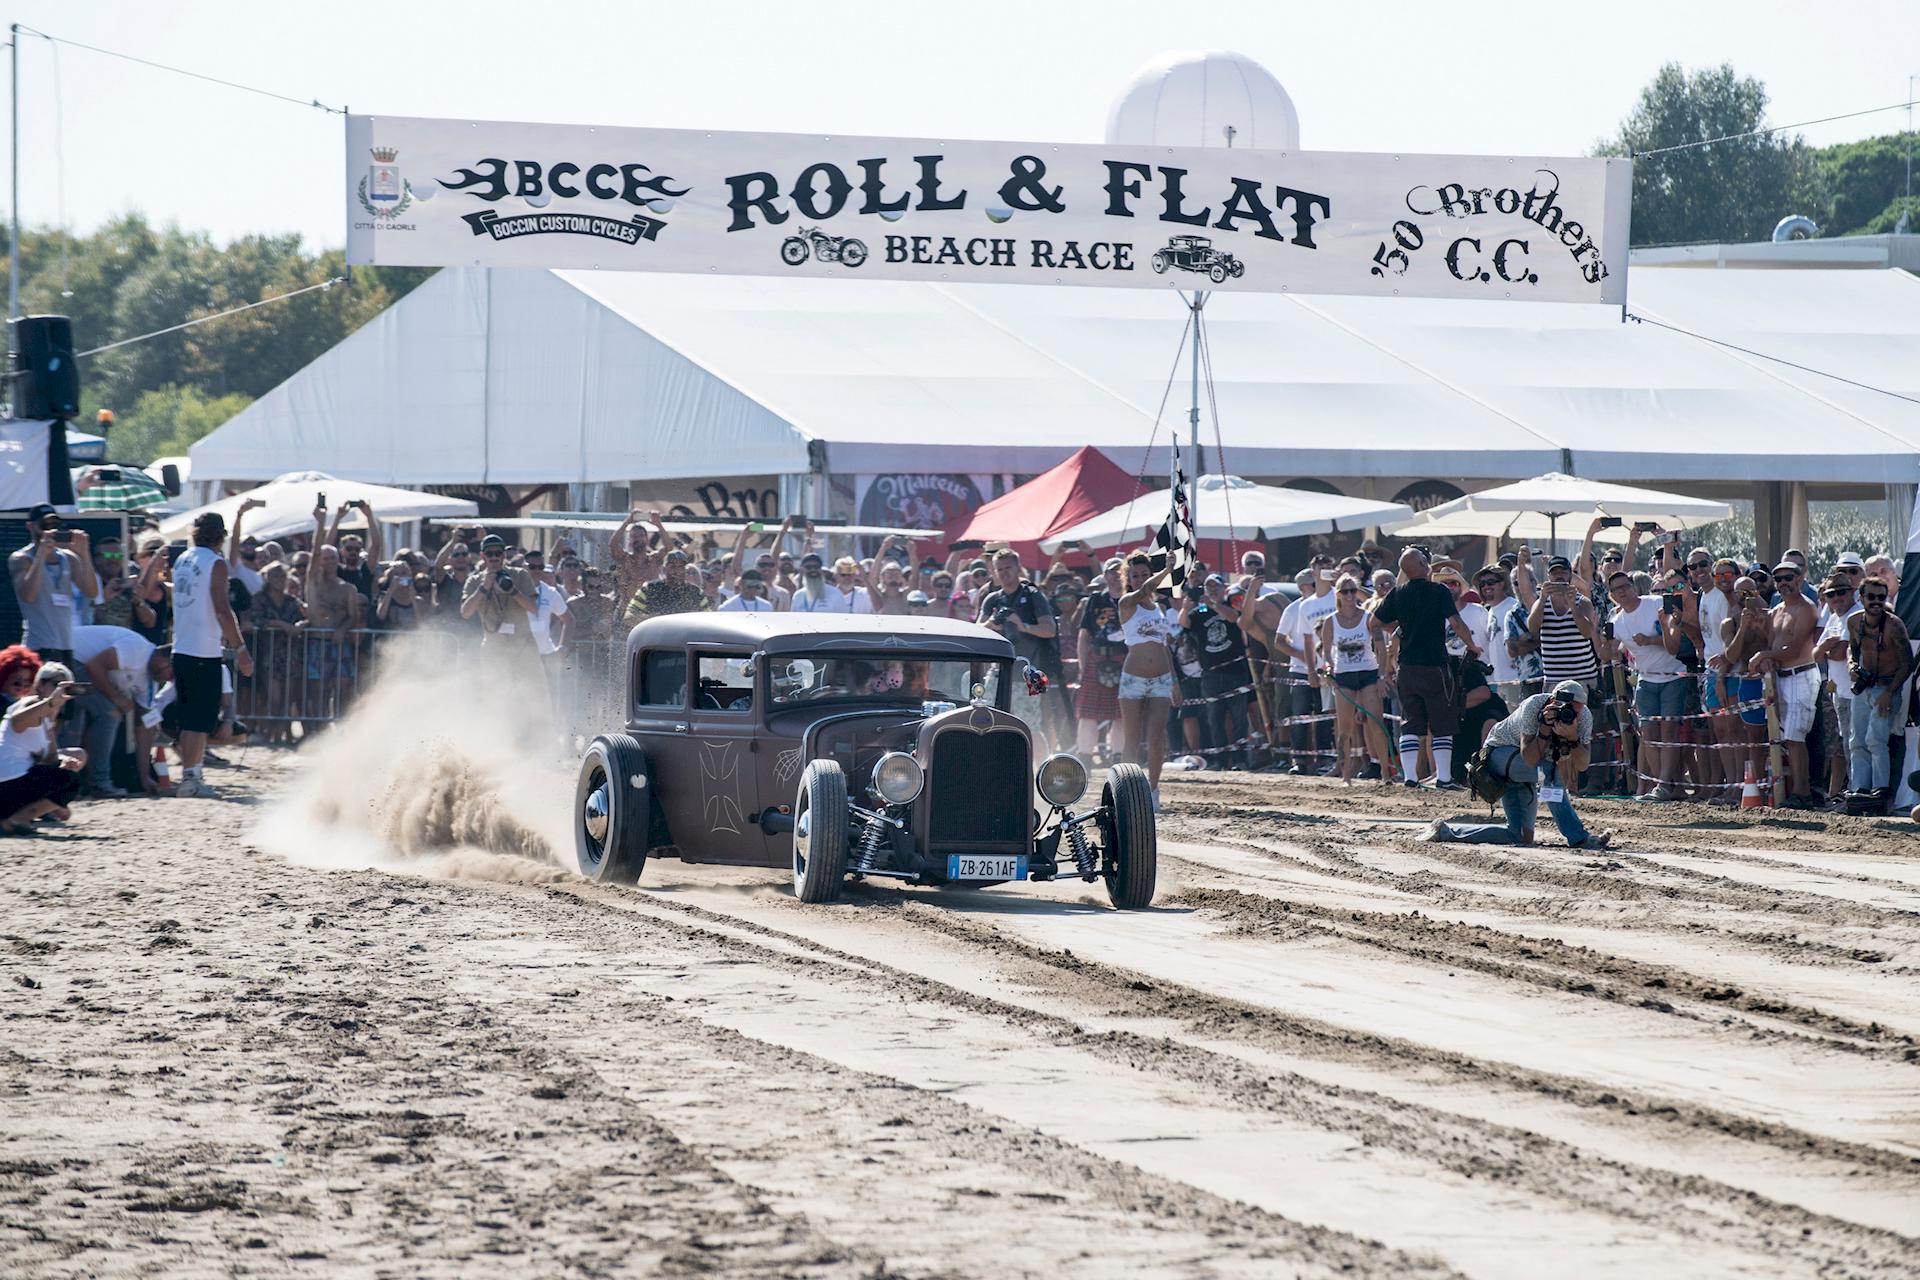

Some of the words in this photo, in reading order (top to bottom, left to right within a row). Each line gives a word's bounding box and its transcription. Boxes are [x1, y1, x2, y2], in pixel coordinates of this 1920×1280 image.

[725, 155, 967, 232] ROLL
[996, 155, 1066, 213] &
[1102, 160, 1330, 249] FLAT
[386, 223, 417, 231] CAORLE
[492, 217, 539, 239] BOCCIN
[539, 216, 590, 233] CUSTOM
[591, 218, 637, 243] CYCLES
[1406, 169, 1610, 284] Brothers
[885, 235, 1016, 266] BEACH
[1031, 240, 1134, 270] RACE
[1444, 237, 1539, 286] C.C.
[877, 474, 970, 500] Malteus
[960, 860, 975, 875] ZB
[979, 860, 1016, 876] 261AF
